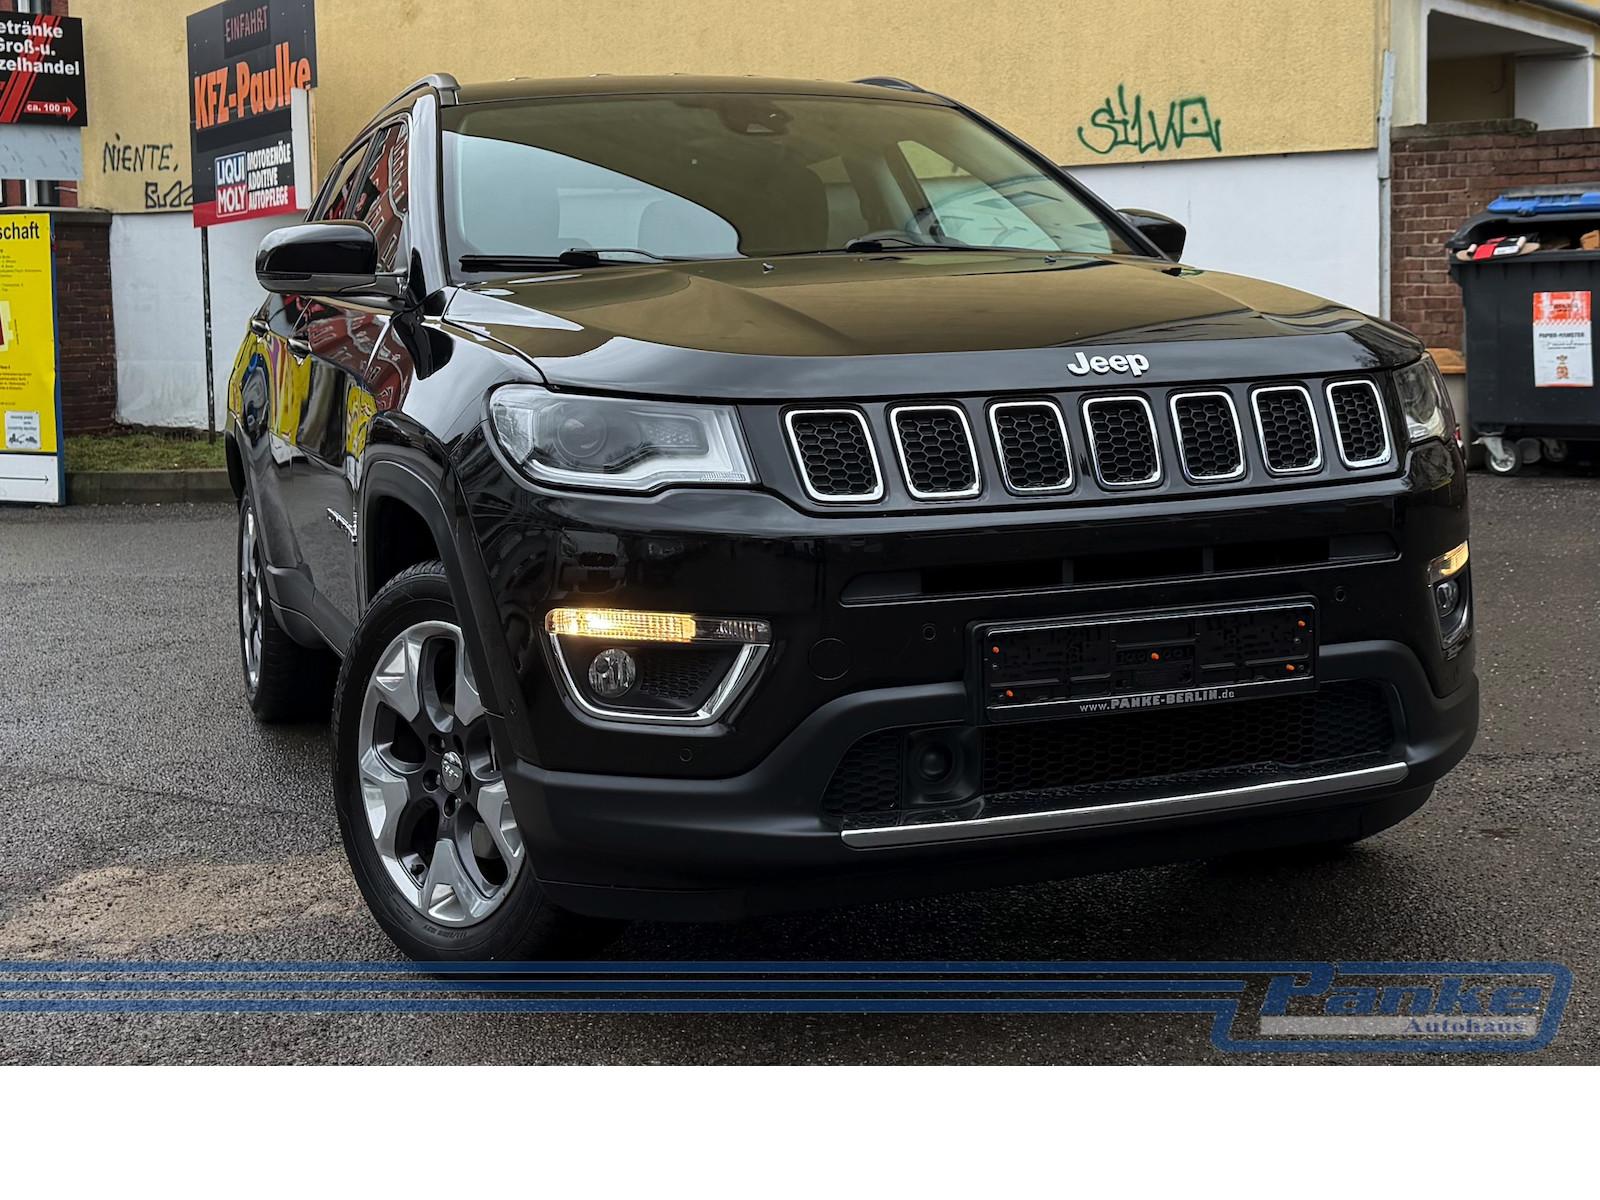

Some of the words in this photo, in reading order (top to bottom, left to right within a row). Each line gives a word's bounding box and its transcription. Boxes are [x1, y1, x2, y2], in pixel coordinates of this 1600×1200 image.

[225, 5, 268, 42] EINFAHRT
[194, 41, 311, 130] KFZ-Paulke
[26, 104, 42, 112] ca.
[44, 103, 61, 112] 100
[247, 140, 292, 171] MOTORENÖLE
[216, 156, 246, 185] LIQUI
[248, 166, 278, 190] ADDITIVE
[217, 185, 247, 214] MOLY
[248, 185, 289, 211] AUTOPFLEGE
[1067, 351, 1150, 377] Jeep
